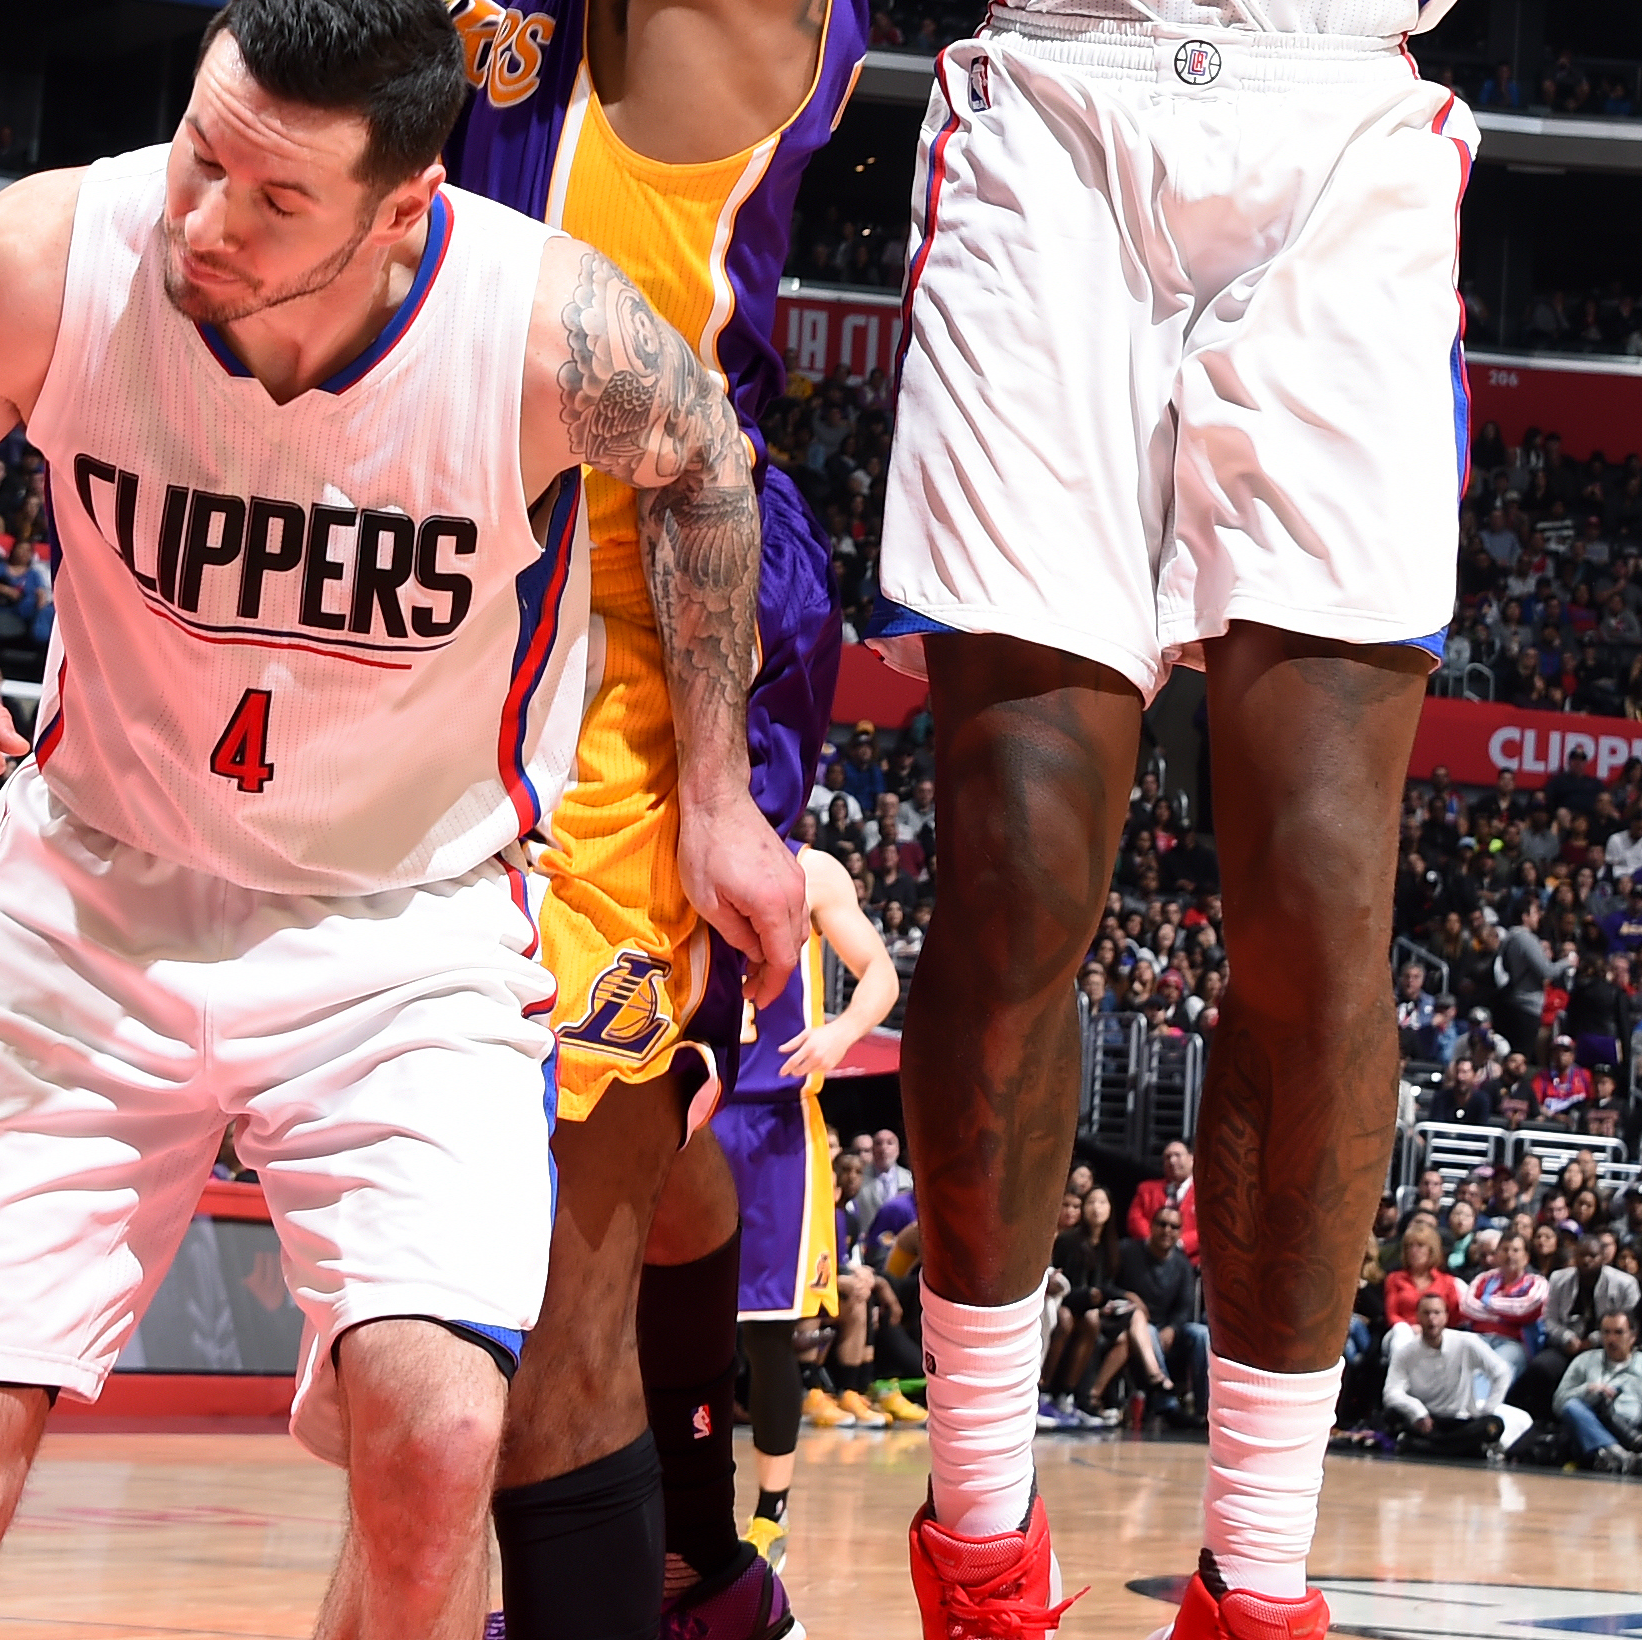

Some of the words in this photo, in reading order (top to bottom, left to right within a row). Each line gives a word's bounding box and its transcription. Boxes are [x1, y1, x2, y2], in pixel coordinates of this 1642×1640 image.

[1489, 370, 1518, 387] 206
[74, 453, 478, 638] CLIPPERS
[209, 688, 275, 793] 4
